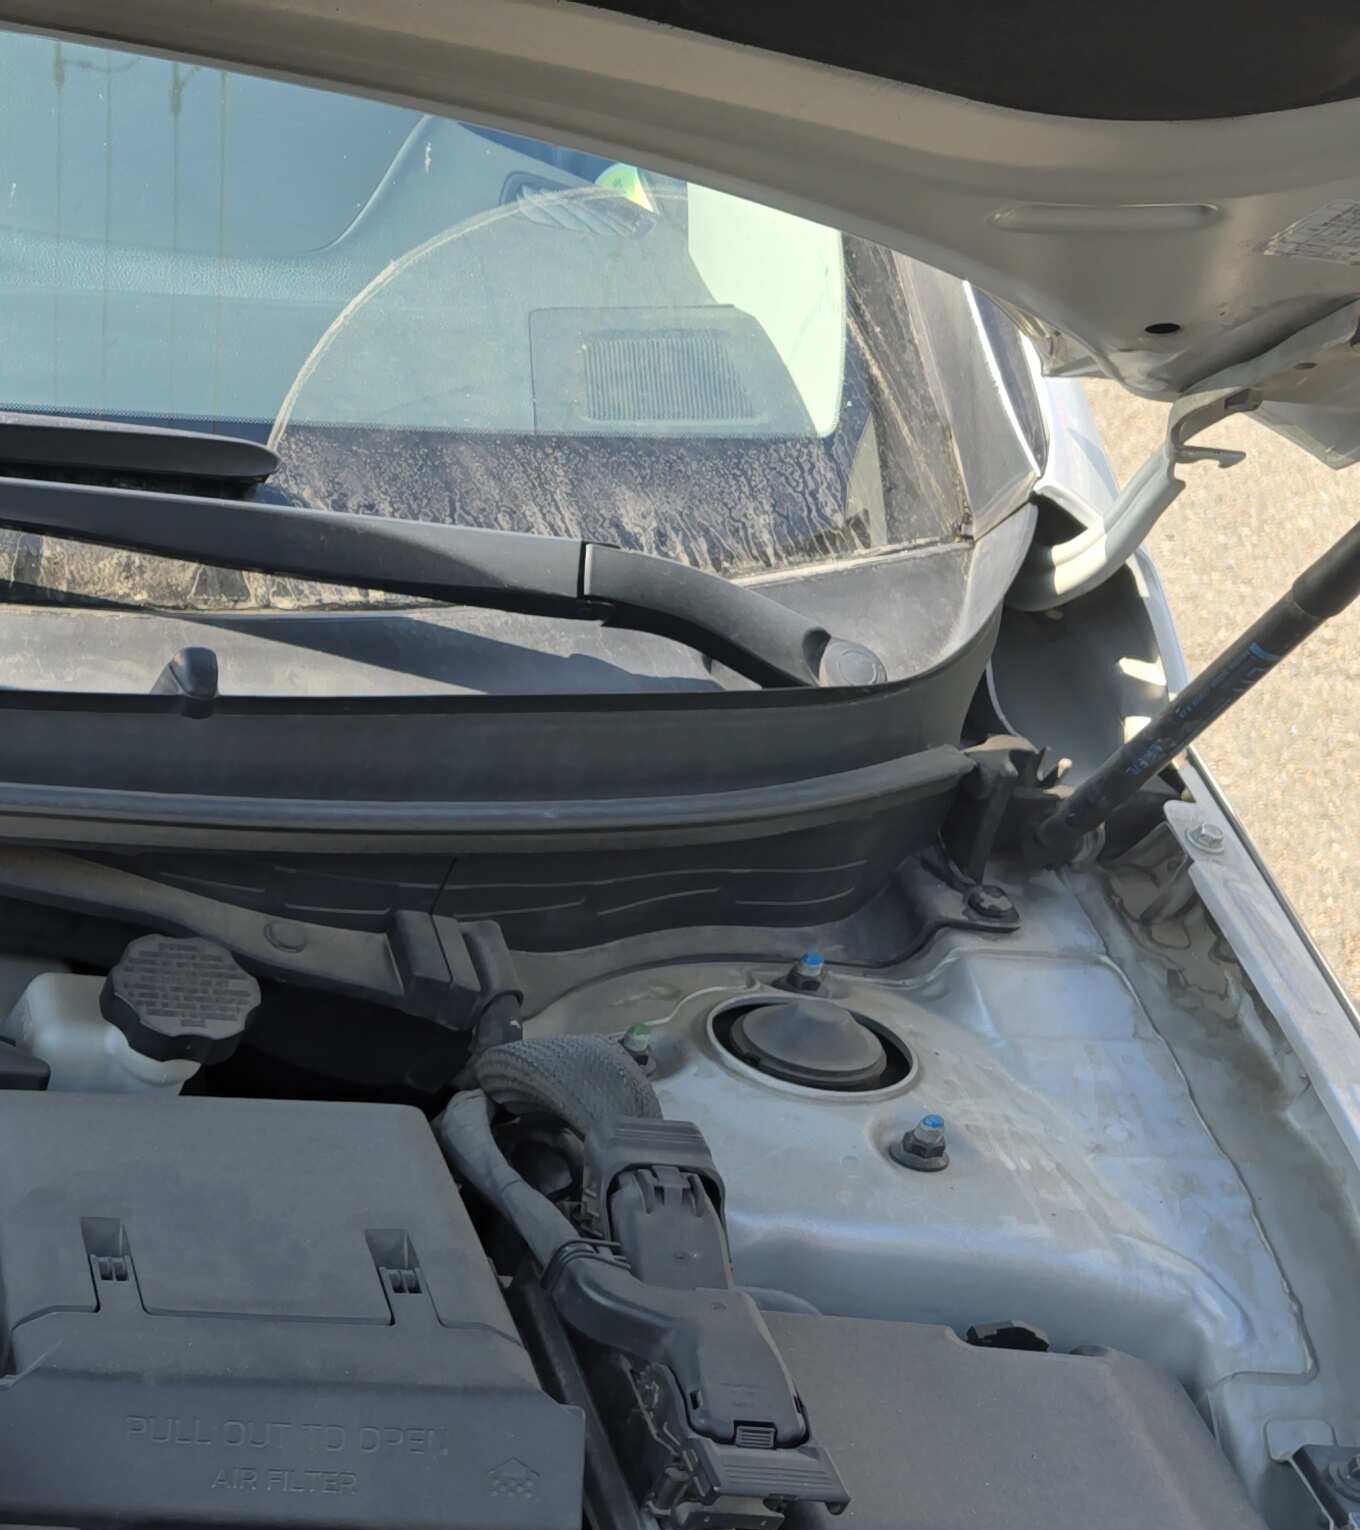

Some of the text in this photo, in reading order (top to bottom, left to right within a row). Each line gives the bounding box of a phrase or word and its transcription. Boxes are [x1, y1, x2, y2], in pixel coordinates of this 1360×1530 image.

[125, 1414, 450, 1456] PULL OUT TO OPEN
[210, 1466, 359, 1496] AIR FILTER
